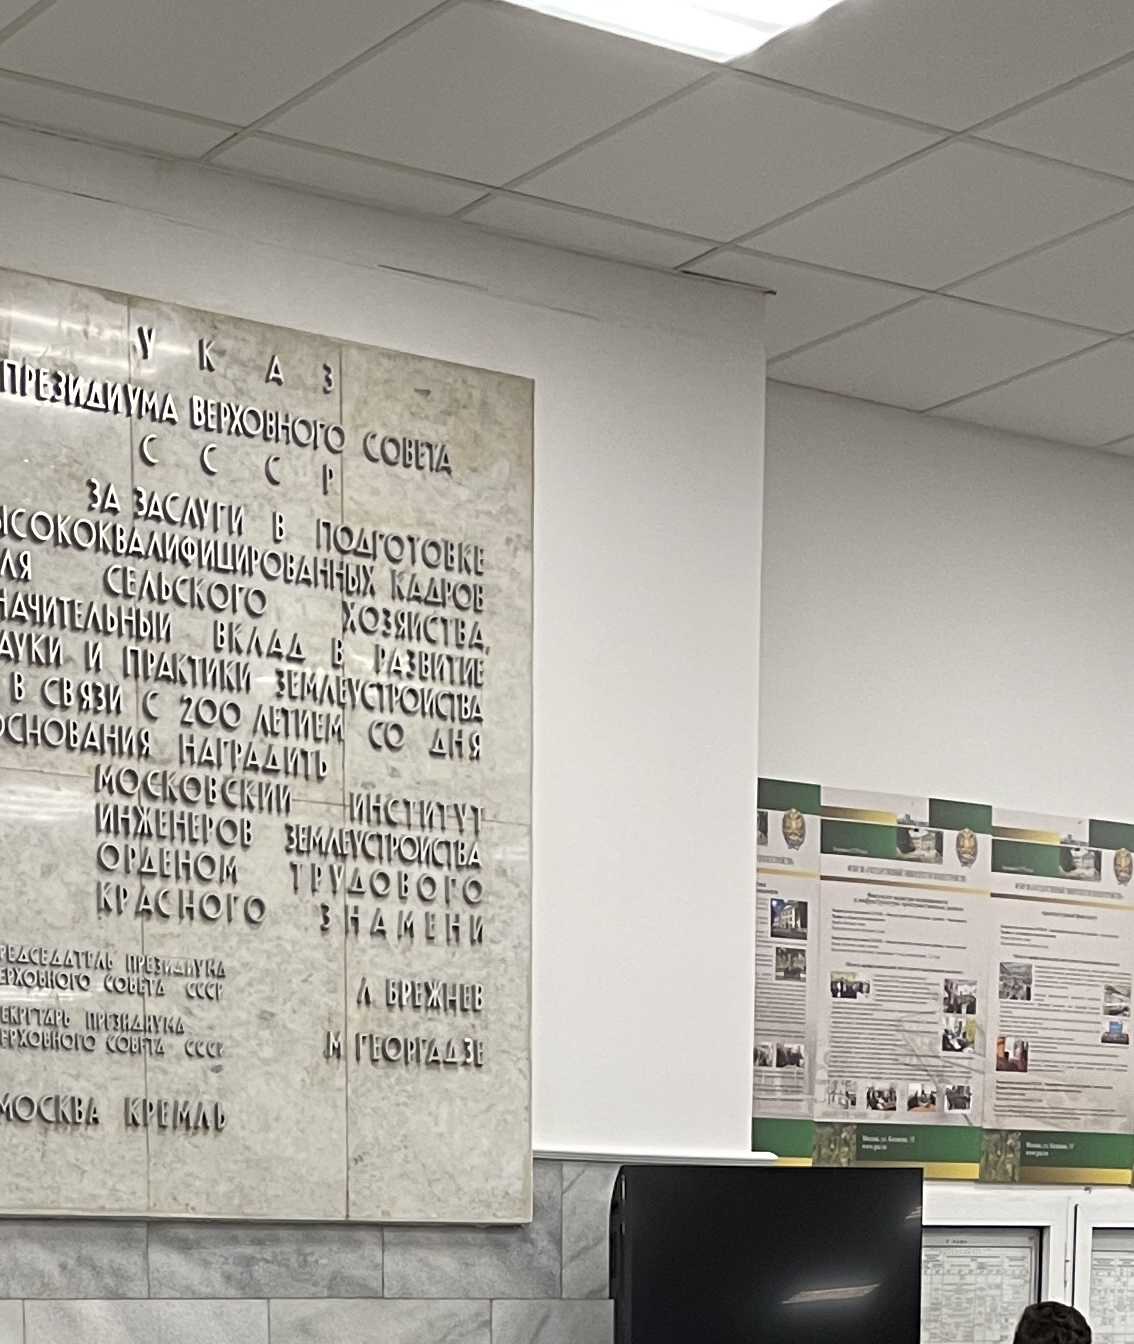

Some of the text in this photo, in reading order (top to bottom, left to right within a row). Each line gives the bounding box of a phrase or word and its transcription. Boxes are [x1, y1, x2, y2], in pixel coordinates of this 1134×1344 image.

[189, 394, 346, 455] ВЕРХОВНОГО
[362, 430, 454, 477] СОВЕТА
[86, 477, 484, 577] ЗА ЗАСЛУГИ В ПОДГОТОВКЕ
[103, 564, 267, 618] СЕЛЬСКОГО
[391, 569, 484, 613] КАДРОВ
[85, 640, 104, 672] И
[123, 645, 251, 693] ПРАКТИКИ
[214, 618, 306, 663] ВКЛАД
[331, 636, 345, 669] В
[375, 643, 485, 688] РАЗВИТИЕ
[12, 671, 26, 703] В
[40, 676, 123, 714] СВЯЗИ
[142, 689, 162, 720] С
[180, 694, 242, 731] 200
[253, 703, 345, 744] ЛЕТИЕМ
[368, 719, 405, 752] СО
[428, 727, 482, 761] ДНЯ
[178, 732, 328, 784] НАГРАДИТЬ
[95, 802, 253, 849] ИНЖЕНЕРОВ
[349, 791, 485, 839] ИНСТИТУТ
[96, 841, 484, 906] ОРДЕНОМ ТРУДОВОГО
[96, 880, 485, 947] КРАСНОГО ЗНАМЕНИ
[104, 973, 166, 997] СОВЕТА
[184, 981, 224, 1002] СССР
[125, 953, 227, 979] ПРЕЗИДИУМА
[384, 977, 485, 1015] БРЕЖНЕВ
[85, 1010, 186, 1036] ПРЕЗИДИУМА
[105, 1033, 166, 1056] СОВЕТА
[184, 1038, 224, 1060] СССР
[354, 1031, 485, 1069] ГЕОРГАДЗЕ
[123, 1095, 227, 1133] КРЕМЛЬ
